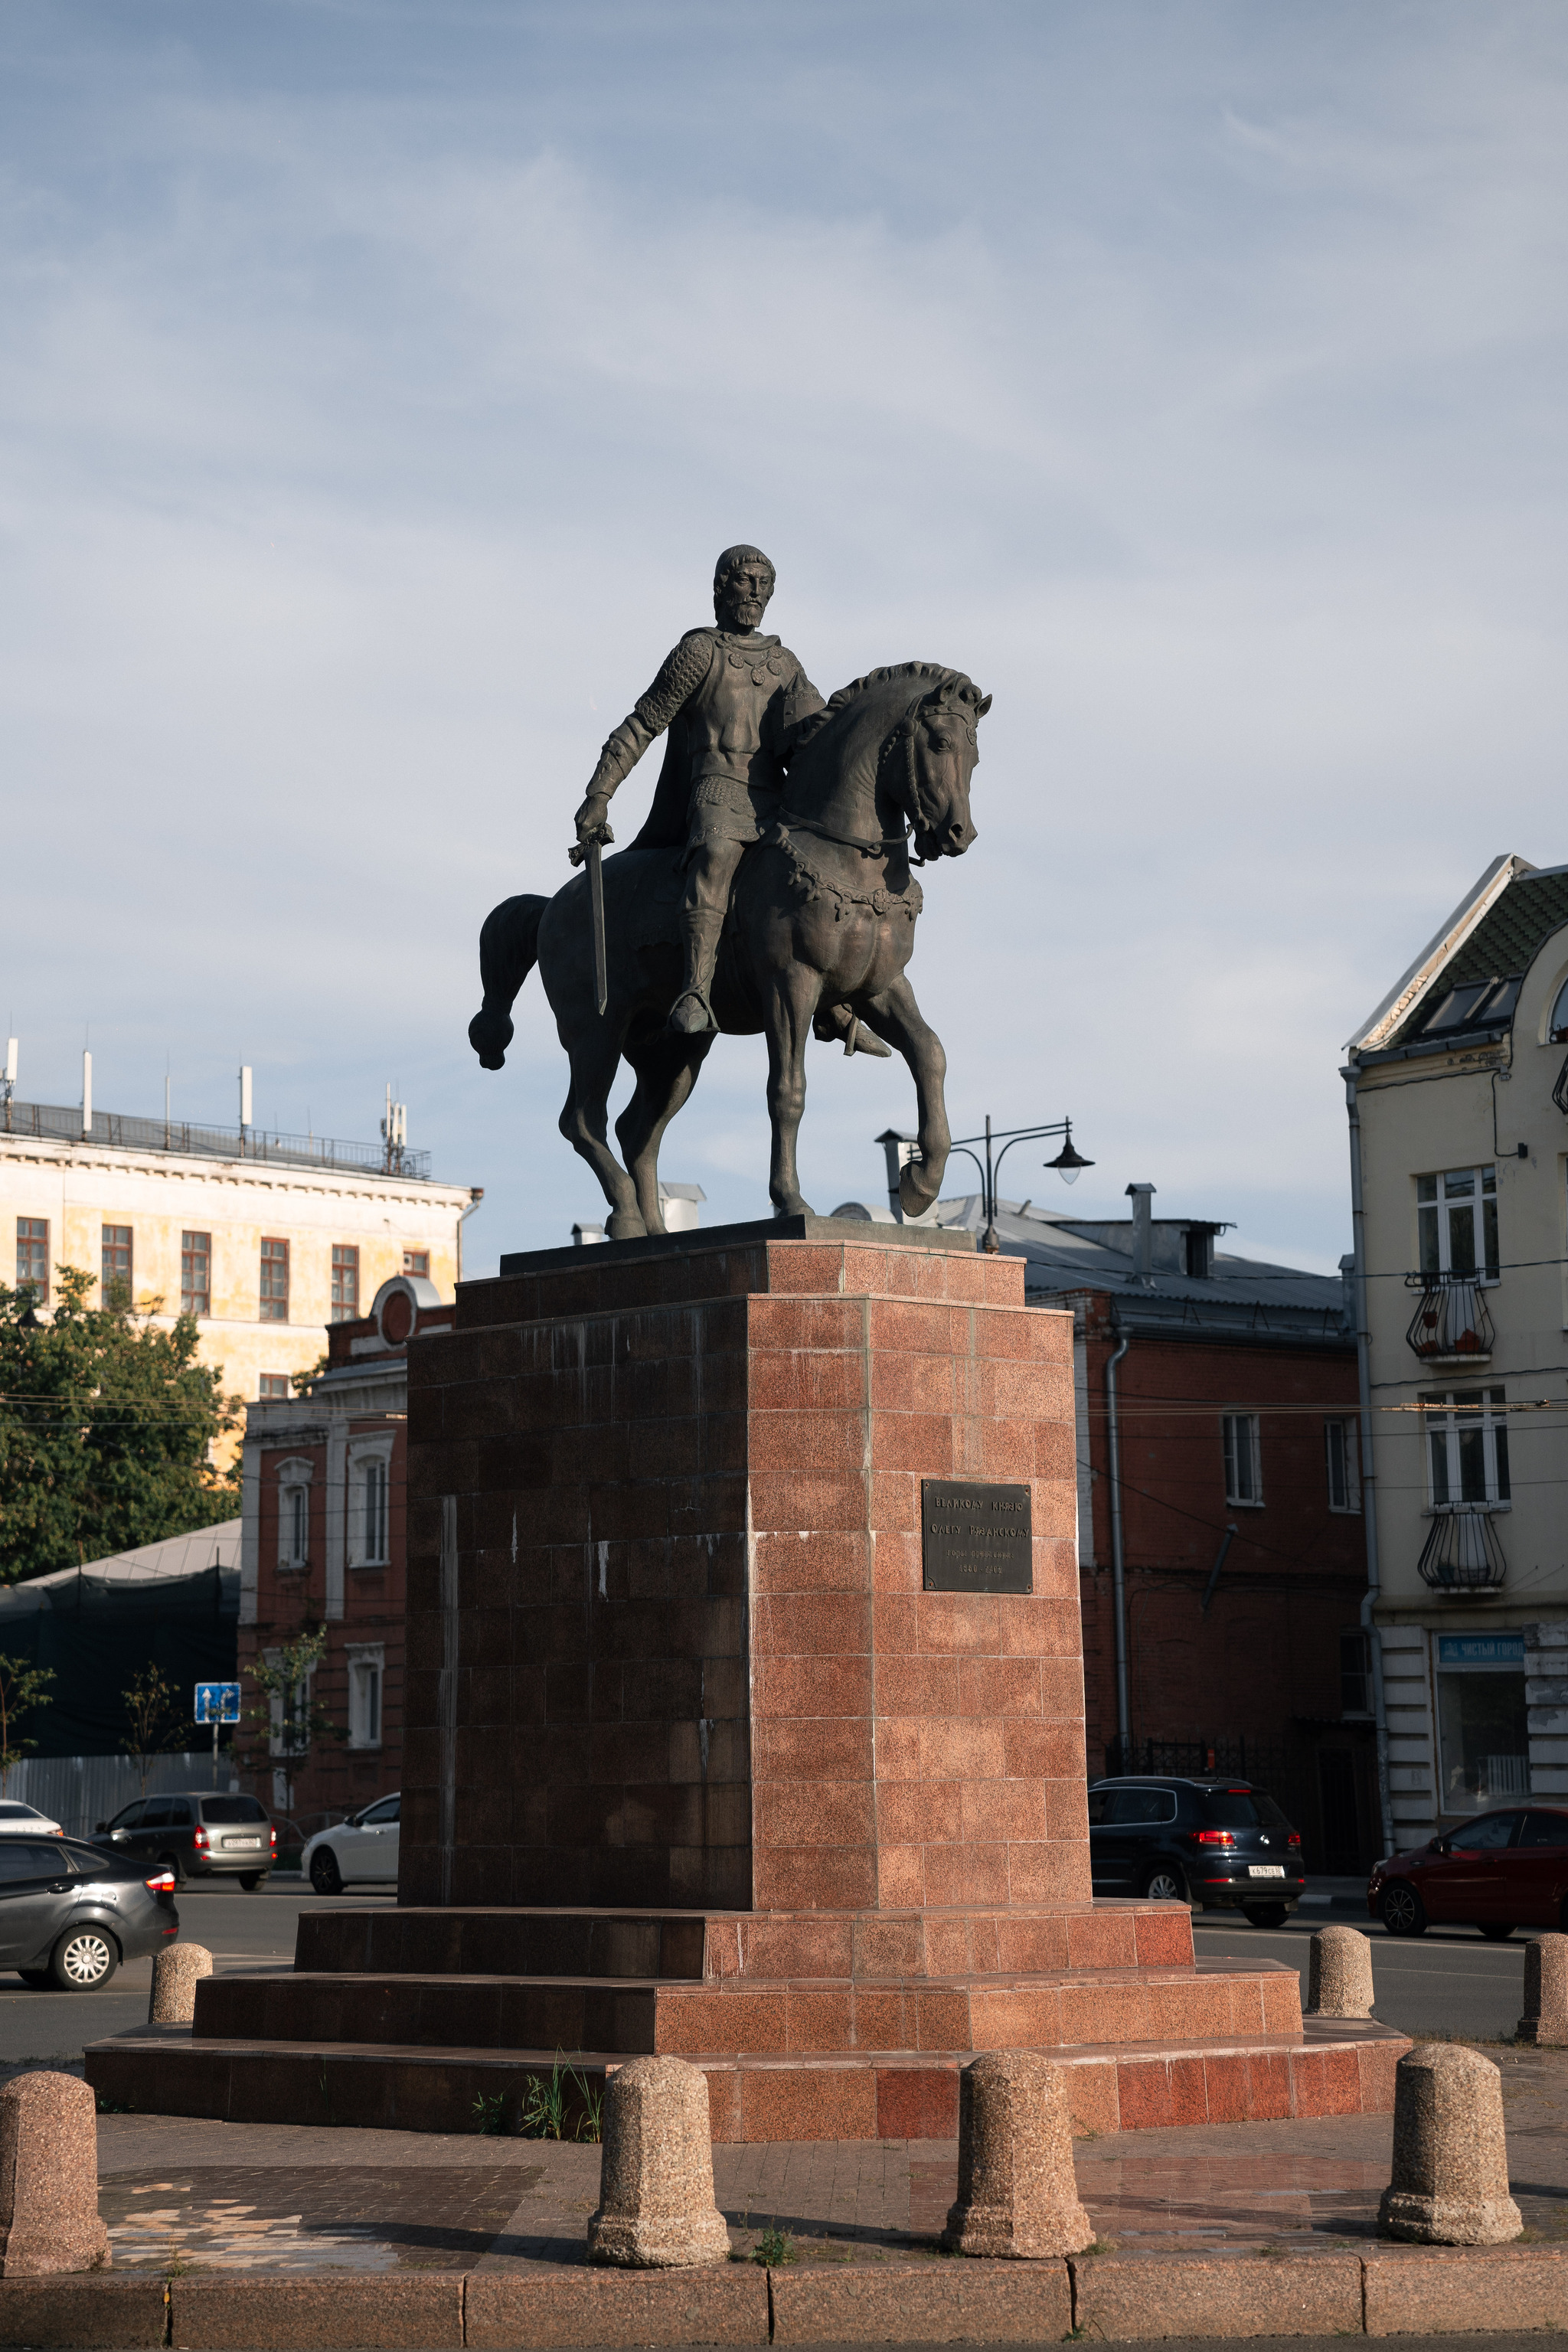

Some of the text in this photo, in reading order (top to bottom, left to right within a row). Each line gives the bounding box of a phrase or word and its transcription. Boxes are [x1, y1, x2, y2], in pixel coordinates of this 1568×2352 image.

[935, 1496, 1023, 1511] ВЕЛИКОМУ КНЯЗЮ
[930, 1524, 1030, 1537] ОЛЕГУ РЯЗАНСКОМУ
[1462, 1642, 1524, 1656] ЧИСТЫЙ ГОРОД
